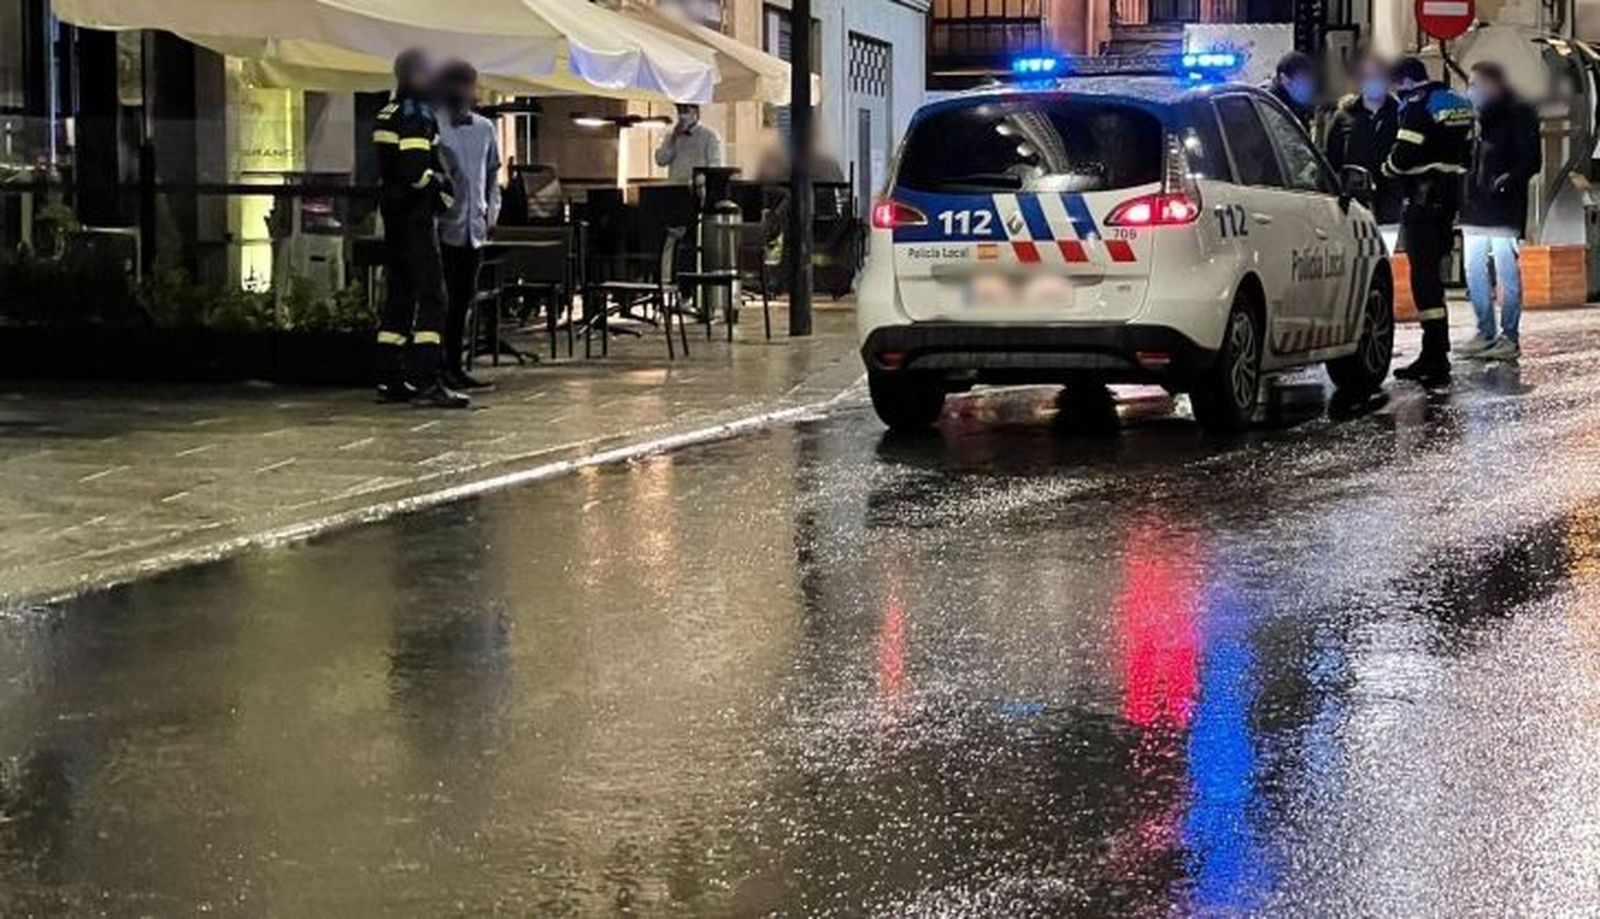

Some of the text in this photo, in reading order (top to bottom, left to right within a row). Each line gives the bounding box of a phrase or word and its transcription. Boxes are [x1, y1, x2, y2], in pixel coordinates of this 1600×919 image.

[937, 210, 992, 235] 112
[1213, 203, 1249, 238] 112
[942, 246, 969, 258] Local
[1324, 245, 1346, 279] Local
